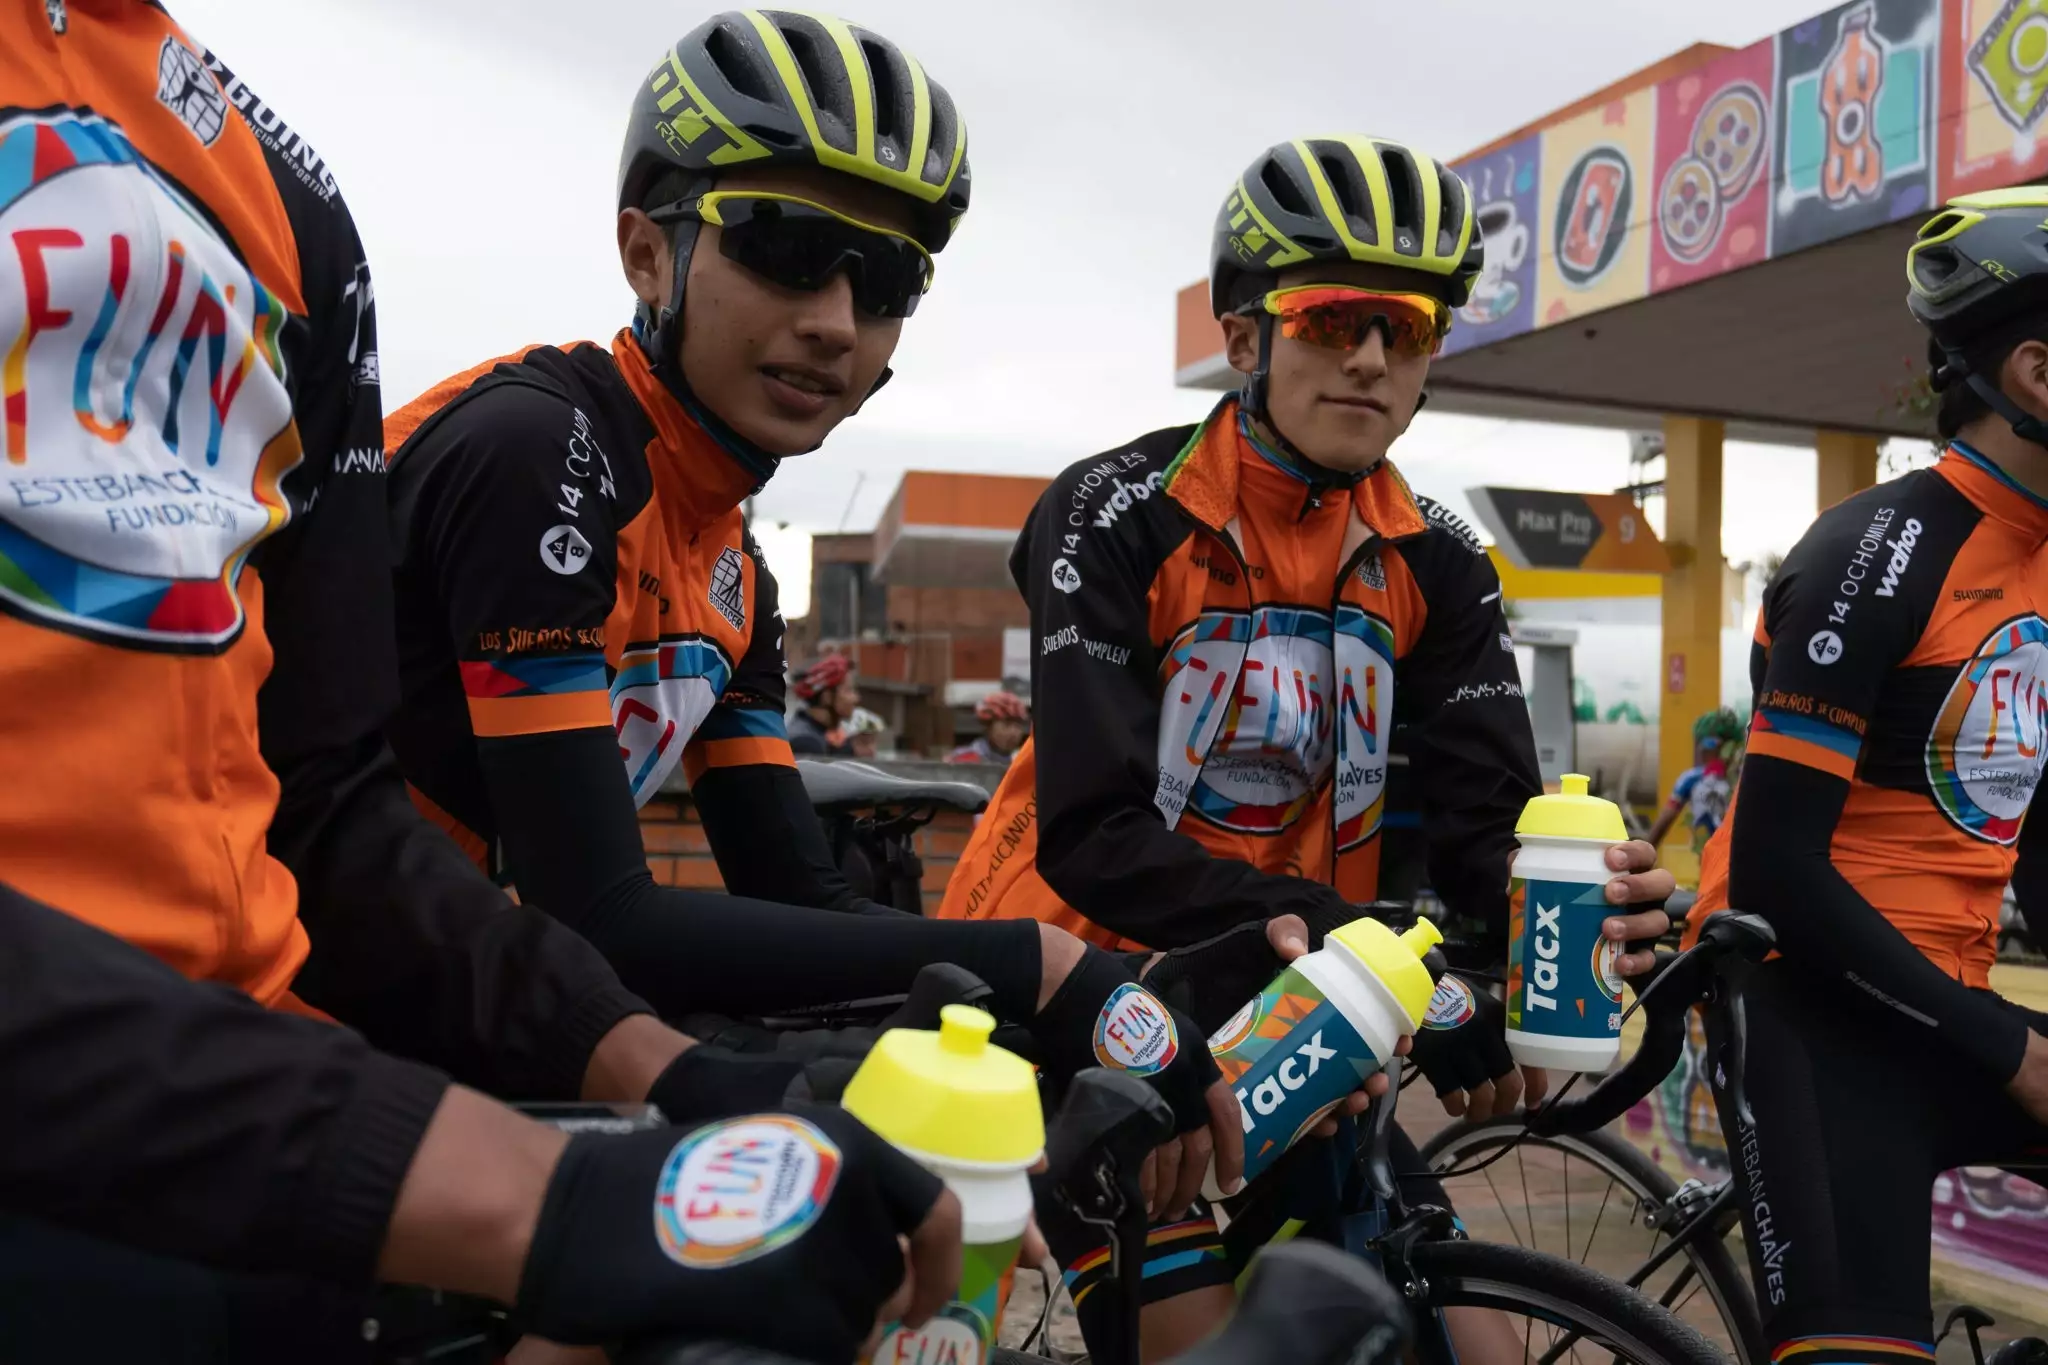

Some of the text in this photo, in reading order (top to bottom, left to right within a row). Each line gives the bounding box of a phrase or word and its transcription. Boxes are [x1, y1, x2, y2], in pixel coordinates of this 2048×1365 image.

[2, 228, 257, 468] FUN
[557, 483, 584, 518] 14
[1516, 509, 1556, 532] Max
[1619, 514, 1636, 544] 9
[570, 545, 586, 558] 8
[1061, 532, 1082, 555] 14
[1828, 507, 1895, 624] 14 OCHOMILES
[1874, 517, 1923, 598] wahoo
[1526, 901, 1560, 1012] Tacx
[1107, 996, 1158, 1057] FUN
[685, 1137, 774, 1222] FUN
